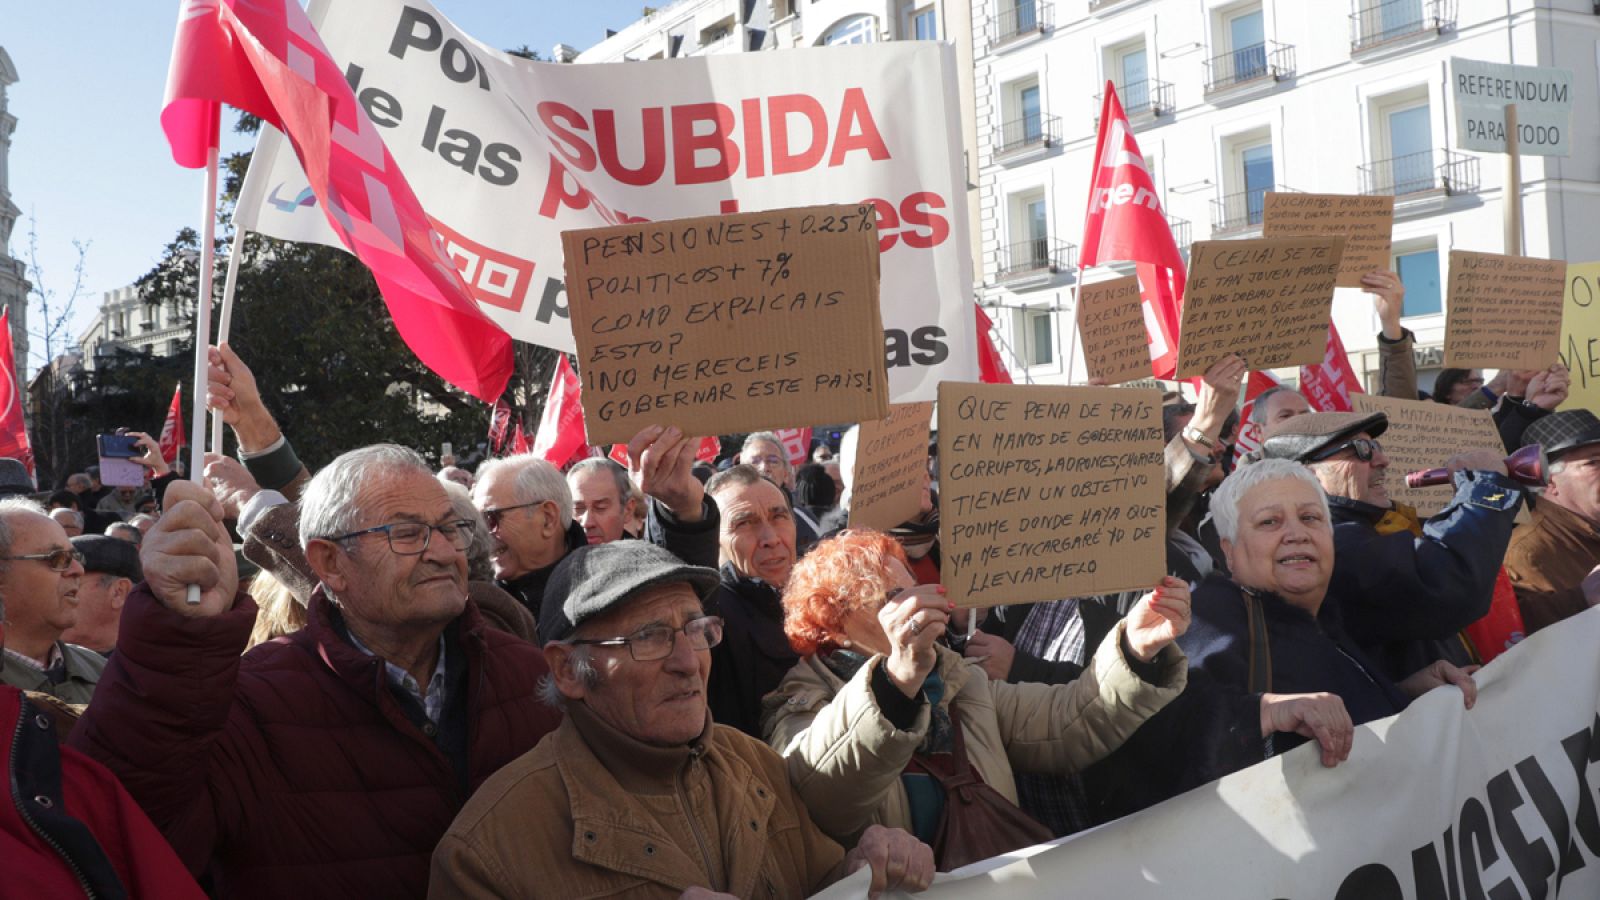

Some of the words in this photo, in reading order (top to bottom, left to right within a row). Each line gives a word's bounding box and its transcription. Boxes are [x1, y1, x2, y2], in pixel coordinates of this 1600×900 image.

[1458, 74, 1568, 103] REFERENDUM
[421, 105, 522, 186] las
[536, 87, 891, 186] SUBIDA
[1467, 119, 1506, 141] PARA
[1516, 124, 1560, 145] TODO
[583, 222, 769, 265] PENSIONES
[800, 204, 876, 235] 0.25%
[756, 252, 793, 287] 7%
[1213, 247, 1275, 270] CELIA!
[1281, 248, 1304, 262] SE
[1311, 247, 1331, 259] TE
[1216, 273, 1244, 287] TAN
[1248, 268, 1291, 283] JOVEN
[591, 304, 672, 335] COMO
[686, 291, 846, 324] EXPLICAIS
[1081, 284, 1139, 310] PENSIO
[1187, 312, 1208, 325] EN
[1214, 309, 1232, 320] TU
[1271, 301, 1297, 315] QUE
[590, 333, 684, 363] ESTO?
[1184, 323, 1233, 342] TIENES
[1183, 343, 1207, 358] QUE
[653, 351, 800, 390] MERECEIS
[599, 382, 737, 422] GOBERNAR
[747, 378, 804, 398] ESTE
[958, 396, 1012, 421] QUE
[1023, 400, 1071, 421] PENA
[1079, 403, 1101, 419] DE
[952, 433, 982, 451] EN
[992, 432, 1045, 455] MANOS
[1049, 431, 1071, 445] DE
[1076, 427, 1163, 445] GOBERNANTES
[952, 486, 1031, 516] TIENEN
[1039, 486, 1065, 500] UN
[1071, 473, 1148, 497] OBJETIVO
[952, 519, 1009, 544] PONME
[1019, 514, 1074, 533] DONDE
[1080, 507, 1120, 527] HAYA
[1127, 504, 1162, 518] QUE
[950, 552, 972, 576] YA
[980, 545, 1000, 567] ME
[1107, 527, 1125, 545] YO
[1133, 526, 1156, 540] DE
[967, 560, 1097, 597] LLEVARMELO
